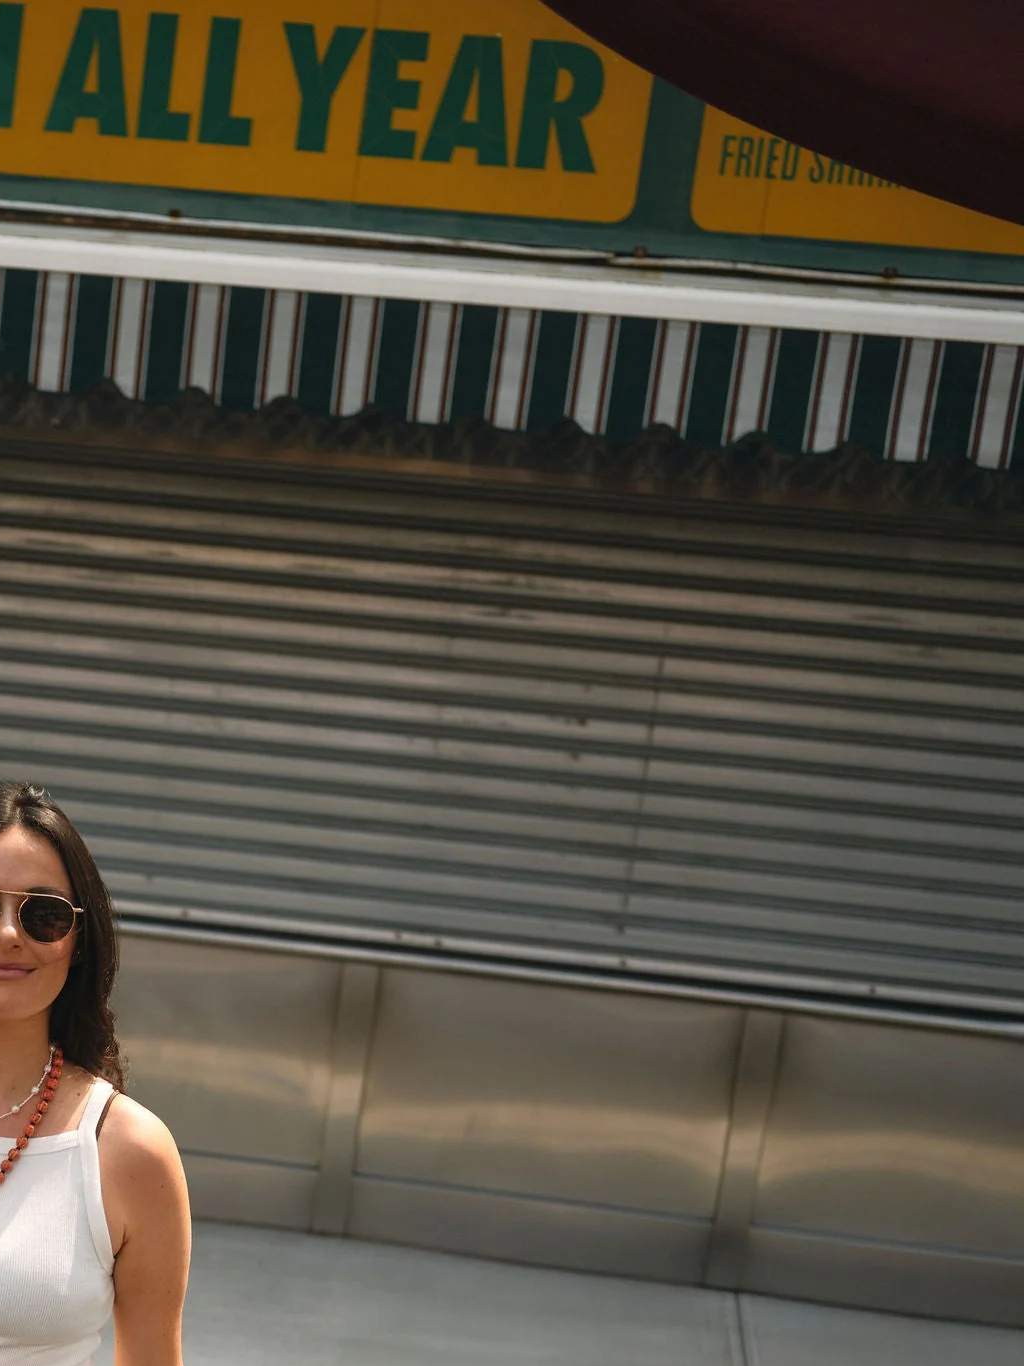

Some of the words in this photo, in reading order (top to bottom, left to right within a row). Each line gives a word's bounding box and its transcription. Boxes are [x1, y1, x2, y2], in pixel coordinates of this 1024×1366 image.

[44, 7, 252, 146] ALL
[282, 22, 605, 174] YEAR
[719, 135, 801, 181] FRIED
